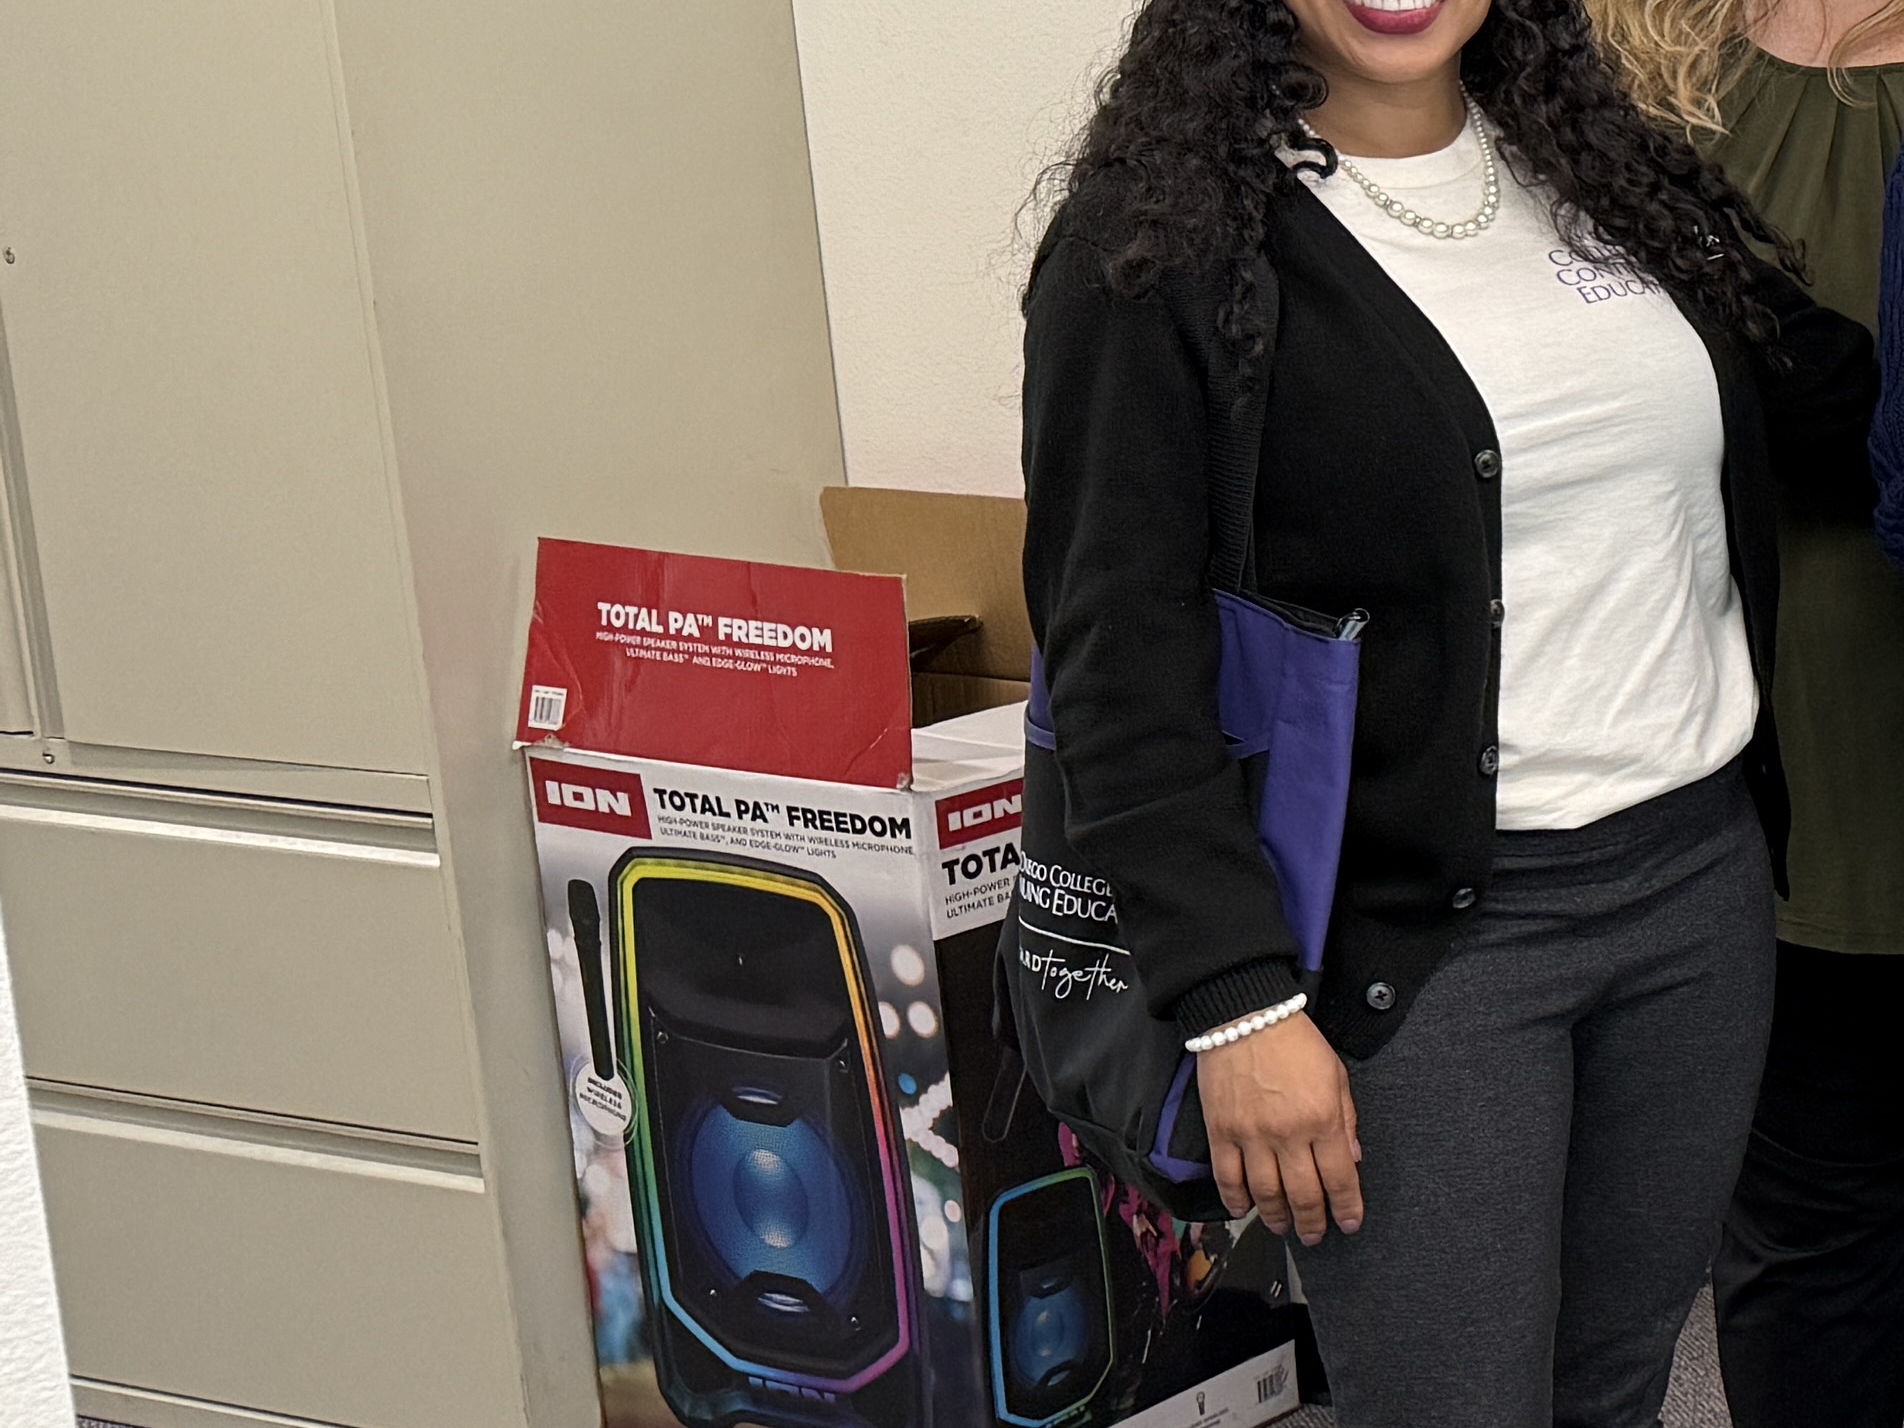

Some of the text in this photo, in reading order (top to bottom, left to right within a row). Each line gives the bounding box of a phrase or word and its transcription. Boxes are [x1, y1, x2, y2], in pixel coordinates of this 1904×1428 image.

[597, 602, 664, 634] TOTAL
[718, 616, 833, 652] FREEDOM
[545, 779, 632, 817] ION
[653, 788, 731, 819] TOTAL
[786, 805, 912, 840] FREEDOM
[947, 794, 1023, 832] ION
[658, 815, 710, 830] HIGH-POWER
[711, 822, 748, 835] SPEAKER
[749, 827, 782, 840] SYSTEM
[784, 832, 806, 843] WITH
[807, 835, 850, 850] WIRELESS
[660, 827, 698, 840] ULTIMATE
[730, 837, 748, 847] AND
[807, 846, 837, 859] LIGHTS
[941, 842, 1021, 886] TOTA
[944, 877, 1011, 906] HIGH-POWER
[946, 898, 995, 919] ULTIMATE
[1052, 889, 1118, 924] EDUCA
